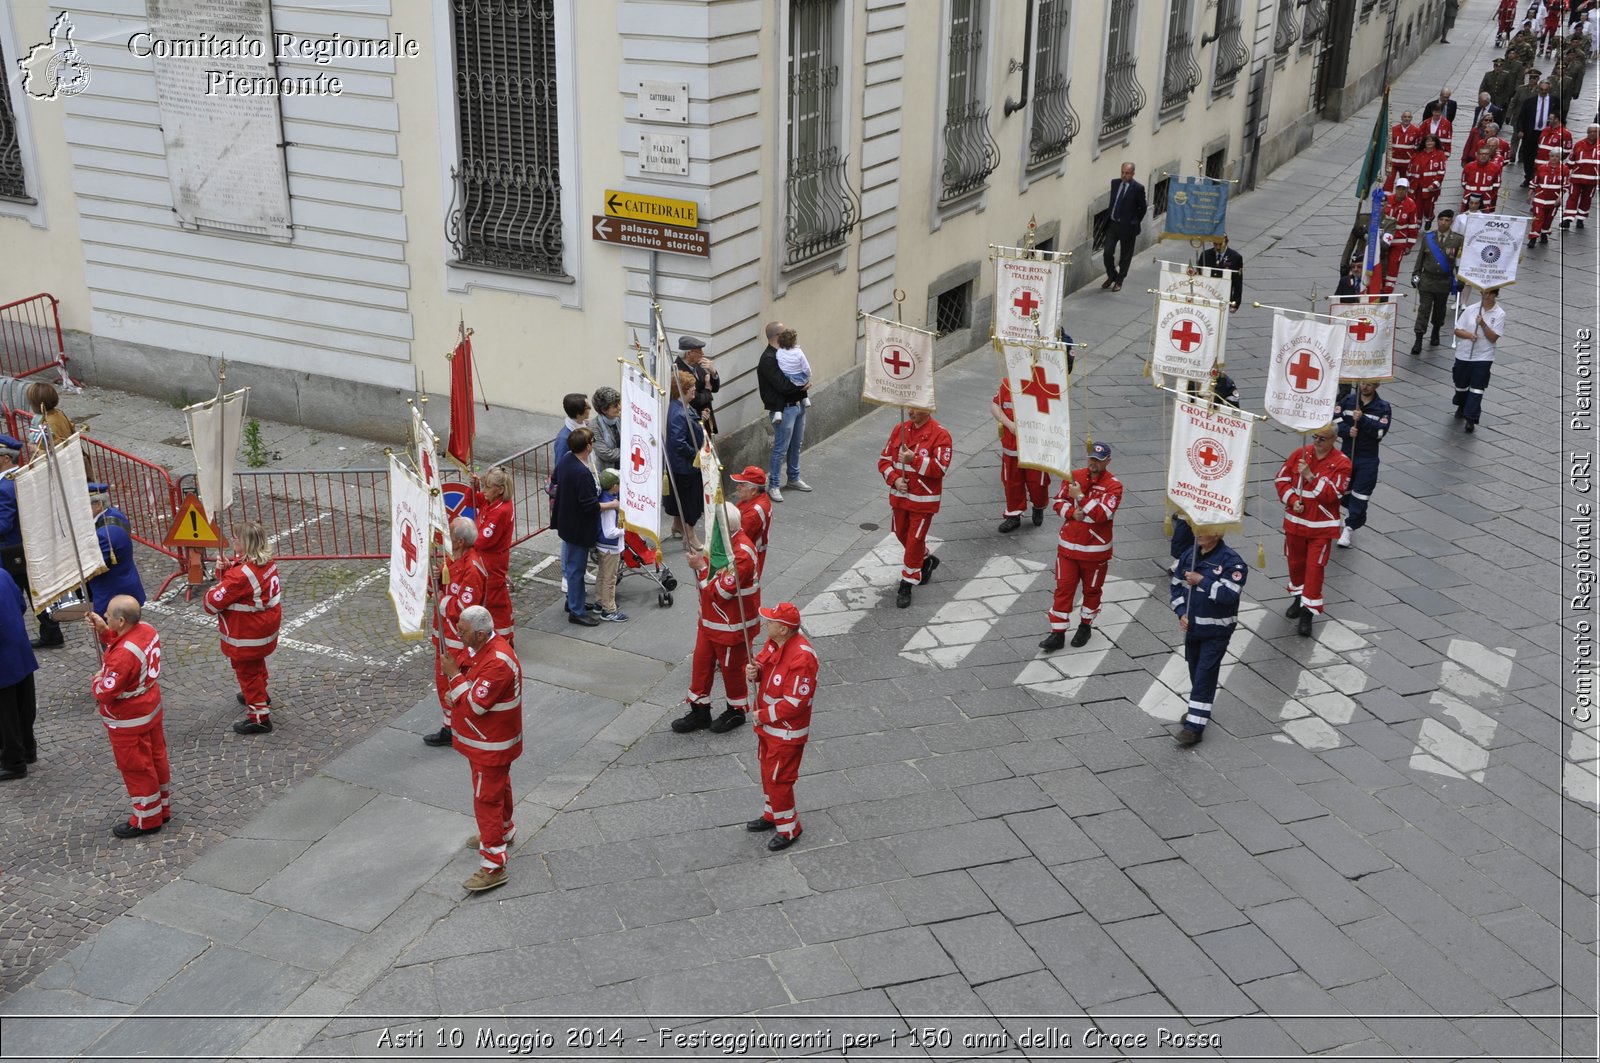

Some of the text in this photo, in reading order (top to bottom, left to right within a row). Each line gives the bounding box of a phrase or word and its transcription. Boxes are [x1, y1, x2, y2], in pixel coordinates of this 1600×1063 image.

[649, 93, 676, 103] CATTEDRALE
[652, 144, 673, 153] PIAZZA
[624, 199, 694, 221] CATTEDRALE
[1484, 220, 1510, 230] ADMO
[620, 224, 705, 242] palazzo Mazzola
[620, 233, 703, 252] archivio storico
[1003, 263, 1052, 274] CROCE ROSSA
[1011, 272, 1044, 282] ITALIANA
[1176, 306, 1194, 315] ROSSA
[1165, 354, 1188, 364] GRUPPO
[1275, 335, 1337, 371] CROCE ROSSA ITALIANA
[881, 386, 917, 398] MONCALVO
[1271, 391, 1331, 407] DELEGAZIONE
[1295, 402, 1304, 410] DI
[1180, 403, 1248, 431] CROCE ROSSA
[1190, 417, 1235, 438] ITALIANA
[1177, 481, 1231, 505] MONTIGLIO
[1170, 488, 1234, 515] MONFERRATO
